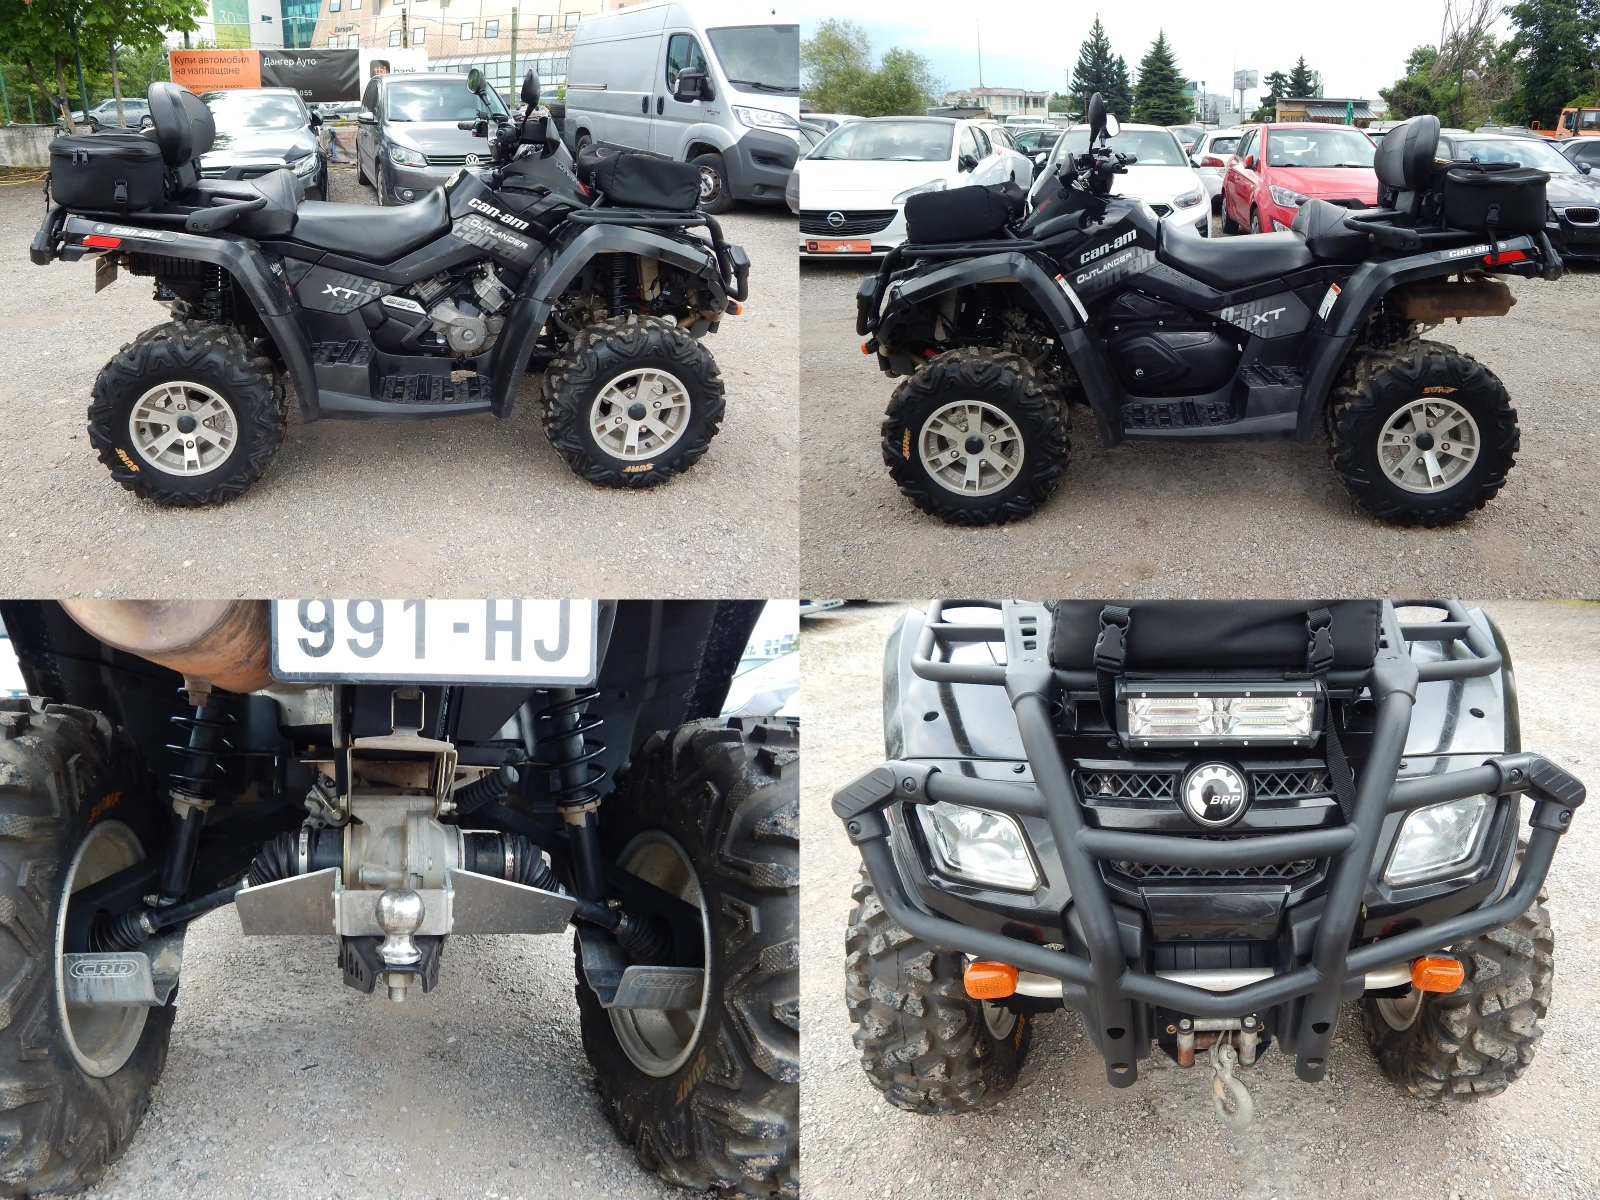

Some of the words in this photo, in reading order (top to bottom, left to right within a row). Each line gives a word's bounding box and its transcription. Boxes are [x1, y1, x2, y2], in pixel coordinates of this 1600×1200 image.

[219, 10, 236, 28] 30
[174, 56, 196, 66] Купи
[198, 56, 250, 65] автомобил
[263, 57, 294, 67] Дангер
[296, 58, 317, 66] Ауто
[175, 67, 186, 76] на
[187, 66, 241, 76] изплащане
[467, 197, 530, 231] can-am
[110, 226, 163, 239] can-am
[469, 219, 529, 250] OUTLANDER
[1080, 228, 1137, 265] can-am
[1449, 244, 1492, 258] can-am
[1076, 252, 1132, 284] OUTLANDER
[321, 283, 360, 300] XT
[1252, 307, 1287, 326] XT
[297, 599, 570, 662] 991-HJ
[1209, 795, 1241, 805] BRP
